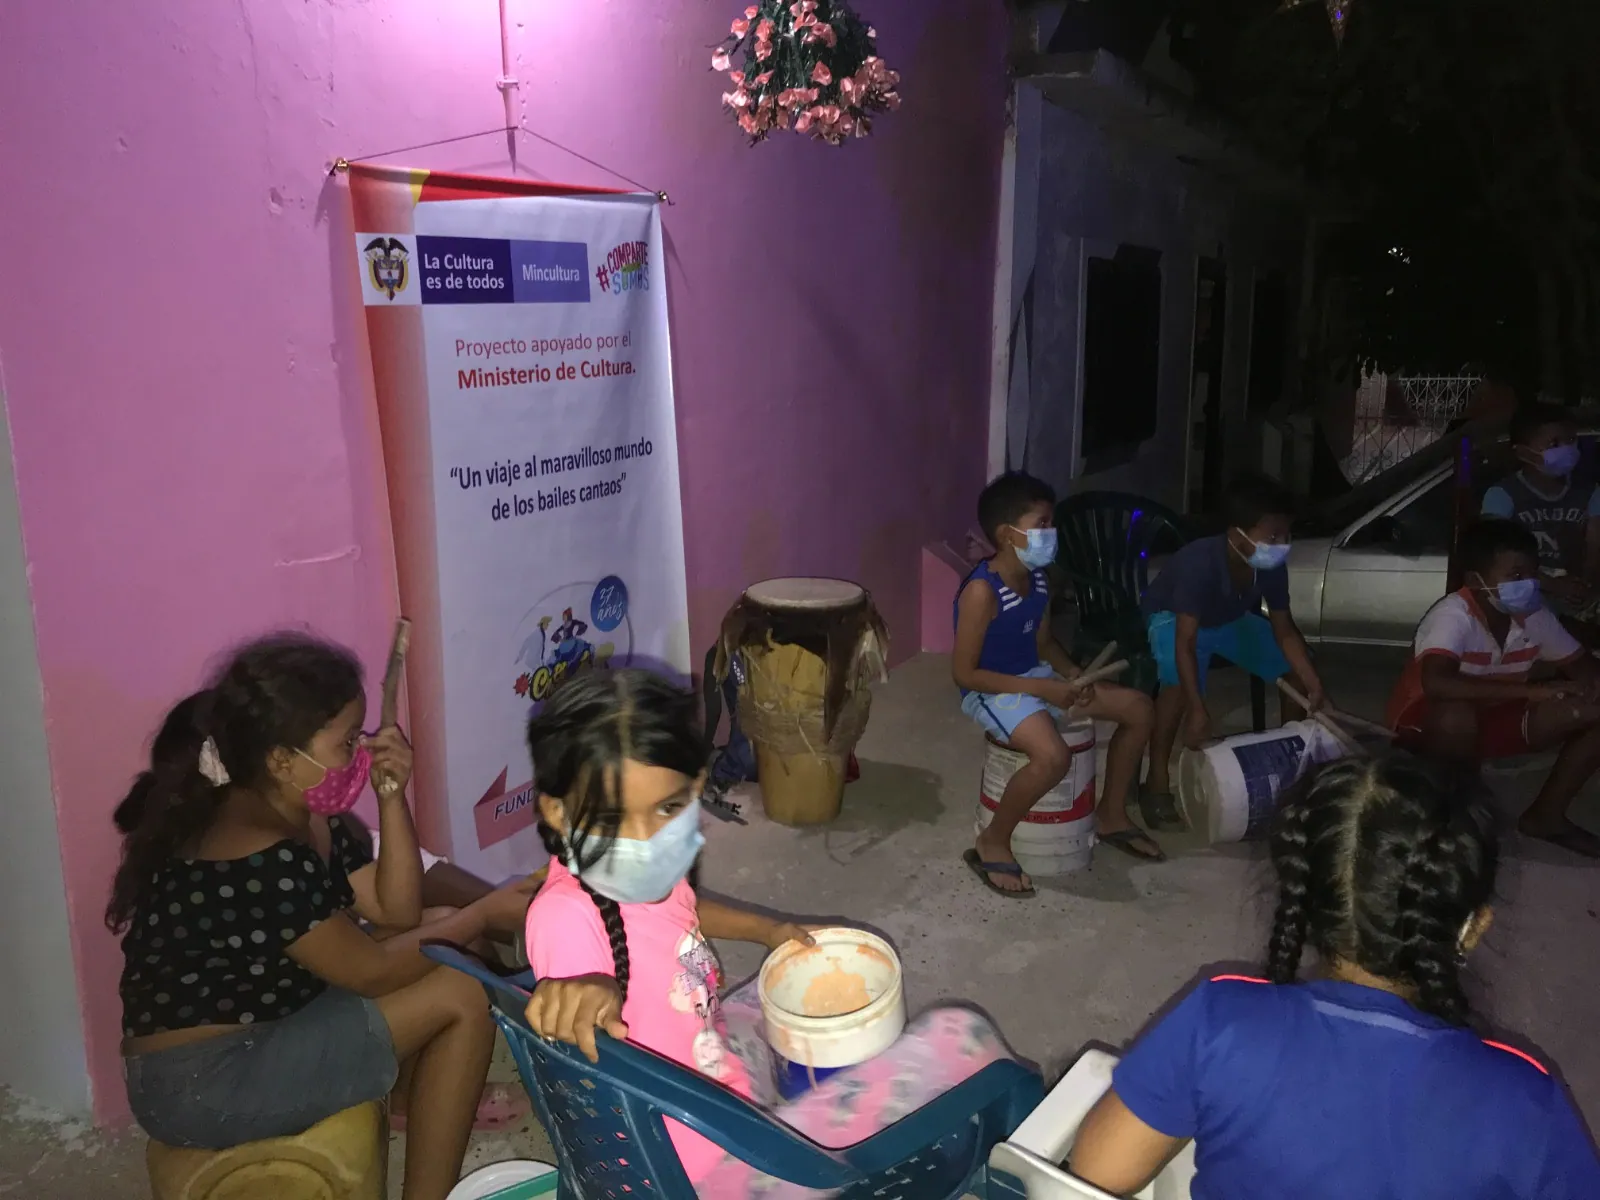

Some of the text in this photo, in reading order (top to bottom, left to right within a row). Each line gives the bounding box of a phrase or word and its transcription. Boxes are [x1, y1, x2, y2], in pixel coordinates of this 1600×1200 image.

[425, 253, 494, 271] La Cultura
[522, 263, 580, 283] Mincultura
[426, 273, 505, 290] es de todos
[456, 330, 632, 358] Proyecto apoyado por el
[458, 358, 637, 390] Ministerio de Cultura.
[450, 437, 653, 490] “Un viaje al maravilloso mundo
[491, 473, 627, 522] de los bailes cantaos”
